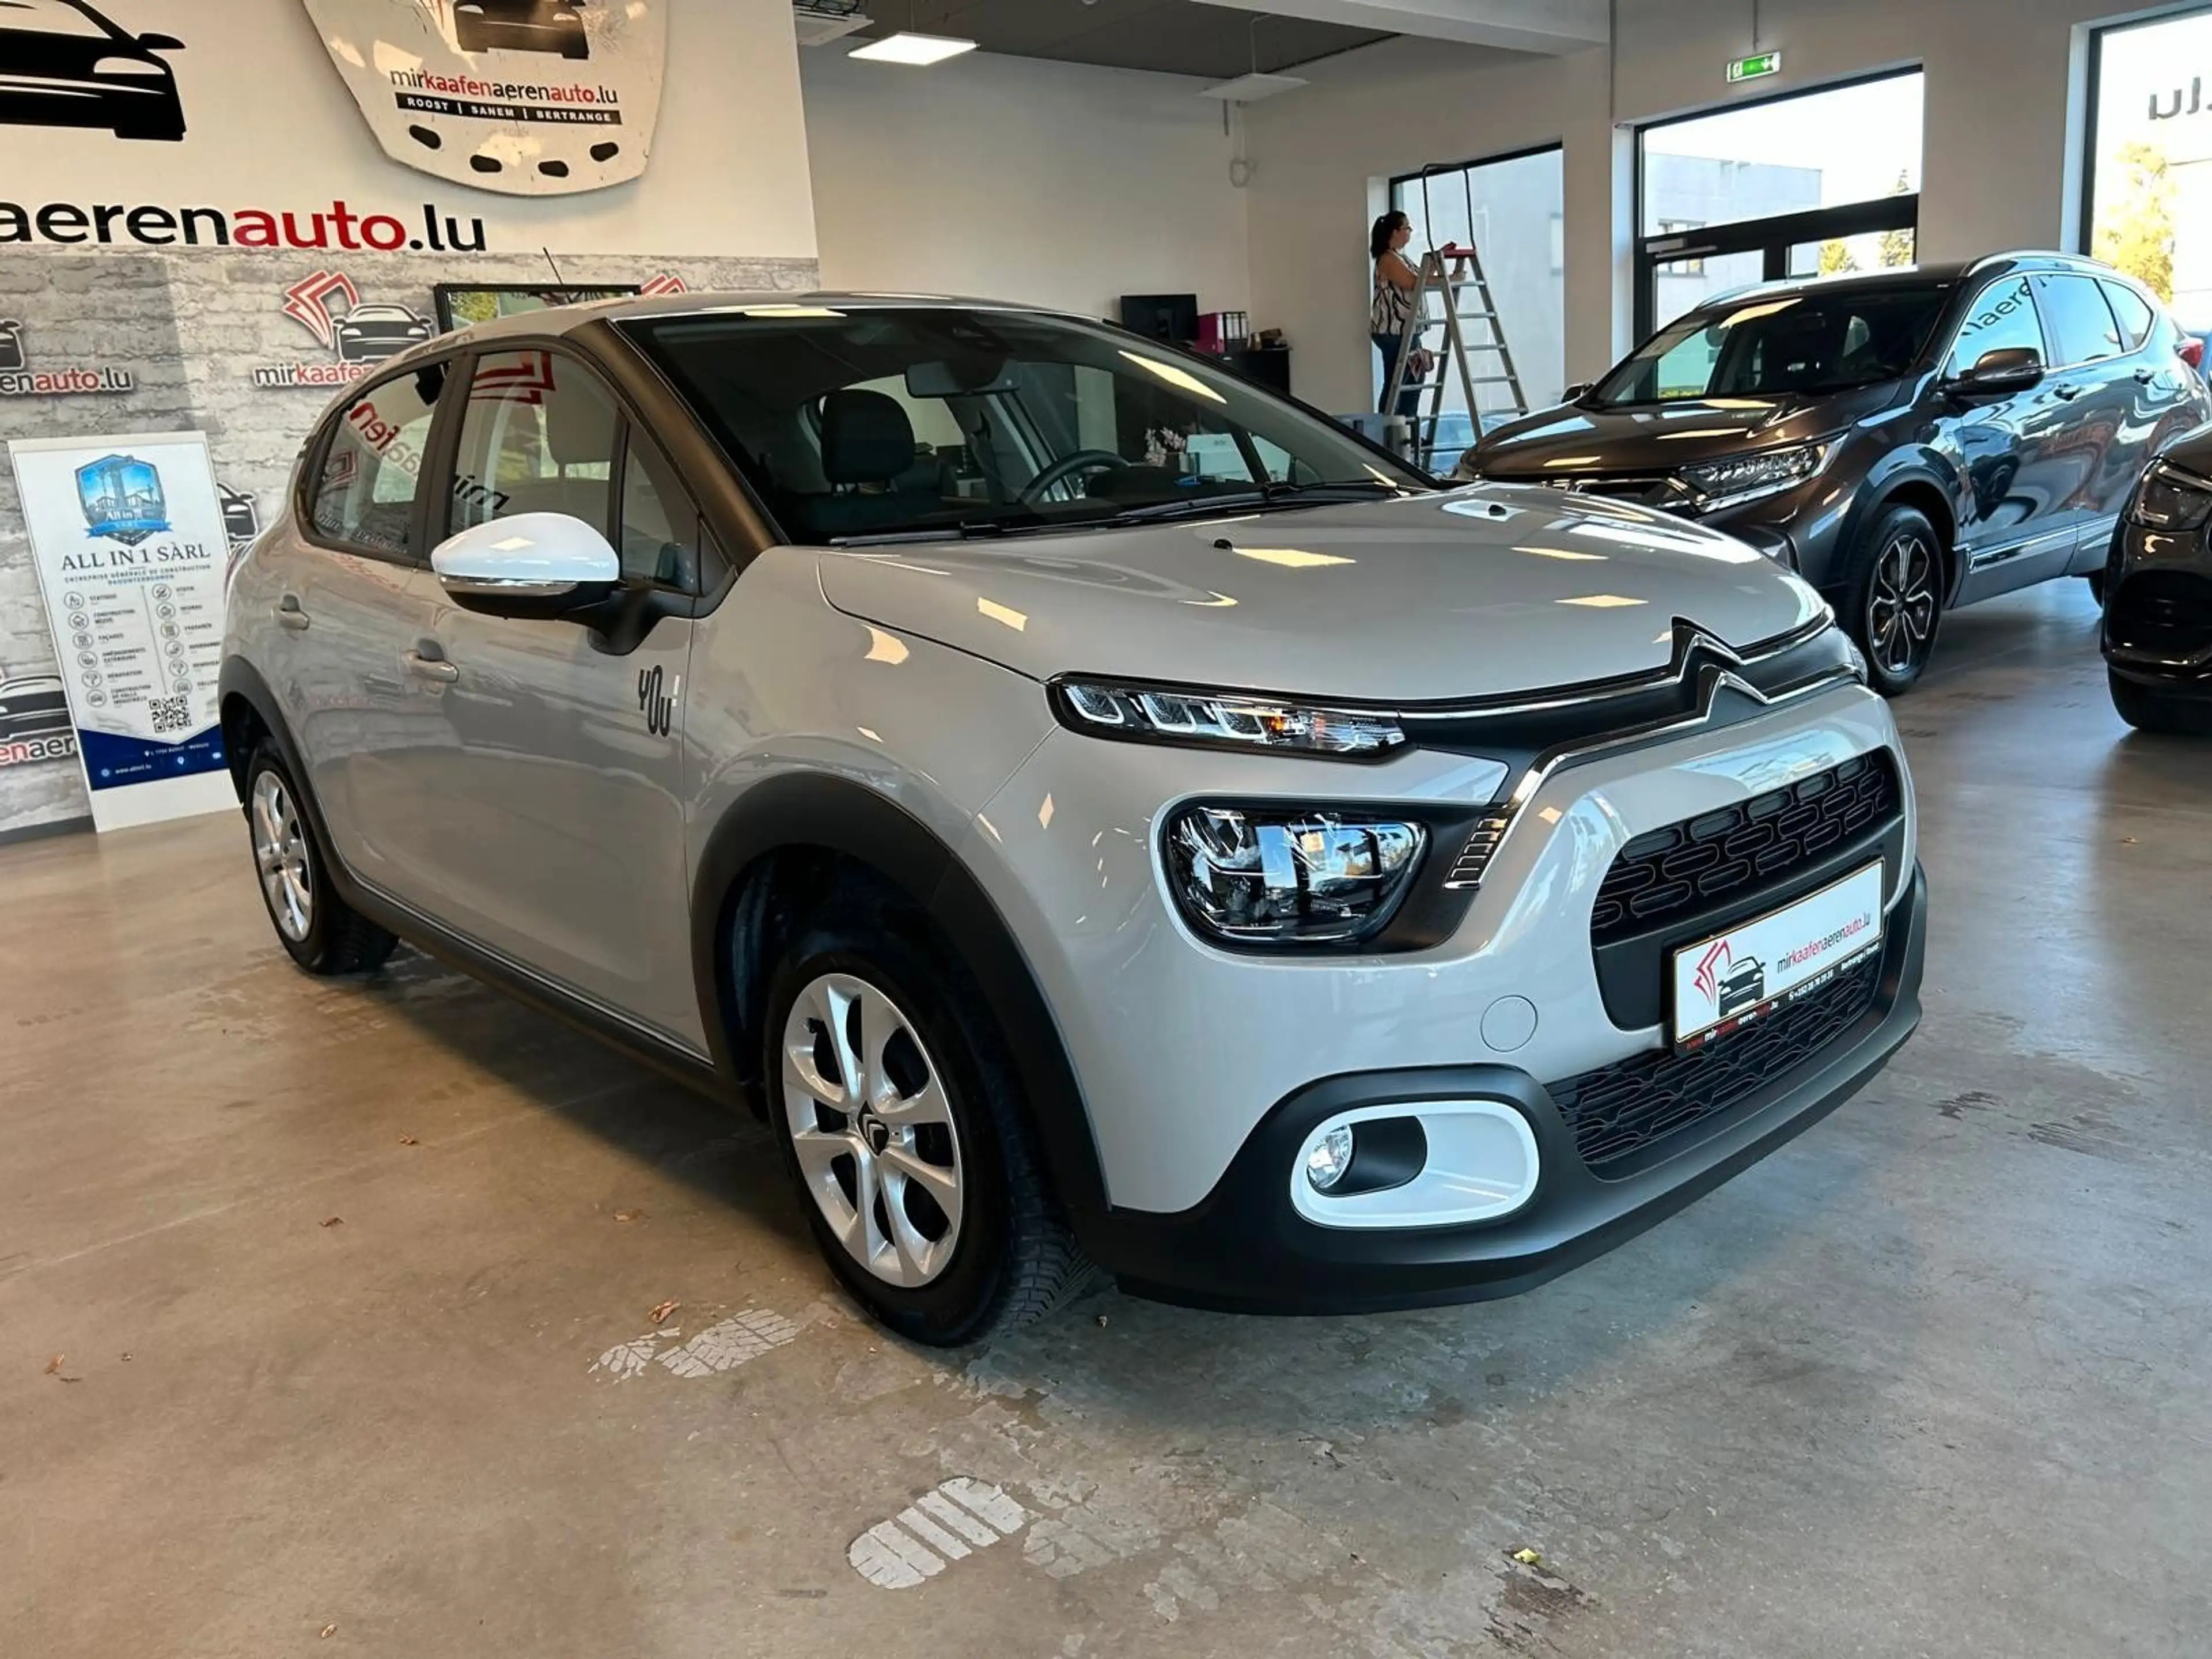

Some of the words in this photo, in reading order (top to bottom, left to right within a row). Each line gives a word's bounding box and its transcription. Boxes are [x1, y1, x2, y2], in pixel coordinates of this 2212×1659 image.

[389, 69, 618, 104] mirkaafenaerenauto.lu
[407, 97, 449, 111] ROOST
[471, 105, 515, 118] SANEM
[536, 109, 612, 122] BERTRANGE
[255, 362, 369, 384] mirkaafe
[62, 552, 105, 570] ALL
[109, 549, 134, 565] IN
[140, 548, 151, 563] 1
[1777, 911, 1871, 974] mirkaafenaerenauto.lu
